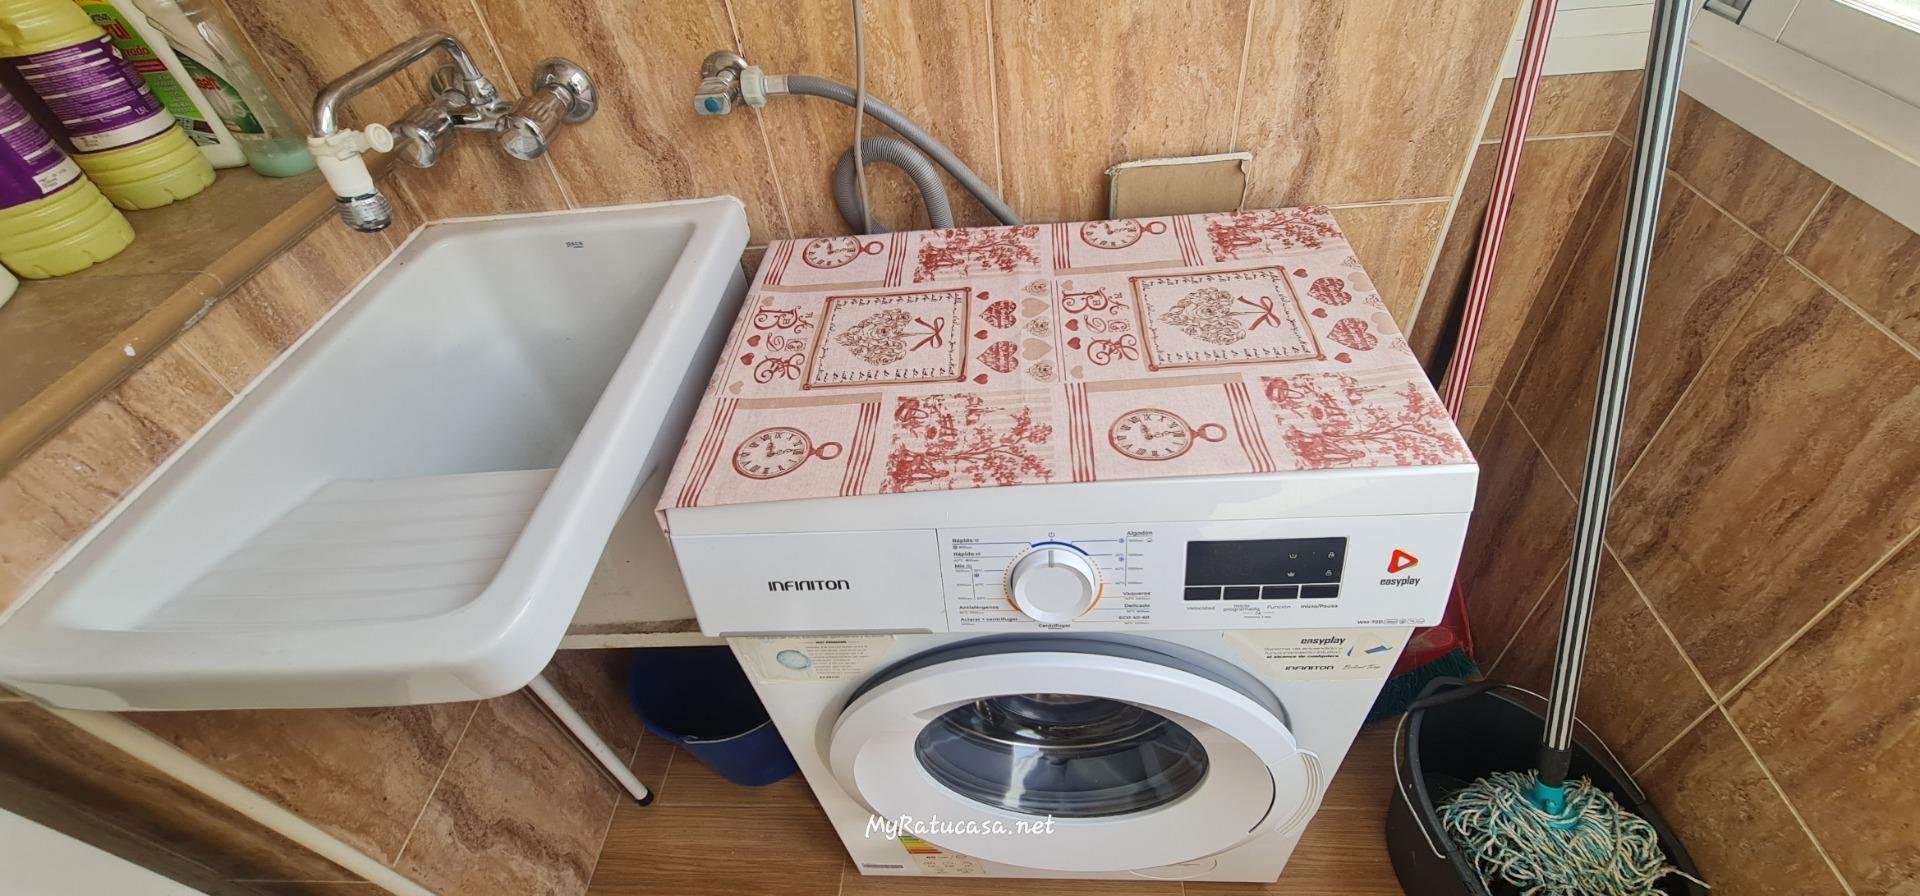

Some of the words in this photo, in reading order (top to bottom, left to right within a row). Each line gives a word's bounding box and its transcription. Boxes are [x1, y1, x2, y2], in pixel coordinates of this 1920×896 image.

[768, 579, 850, 592] INFINITON
[1380, 576, 1421, 587] easyplay
[1300, 636, 1346, 646] easyplay
